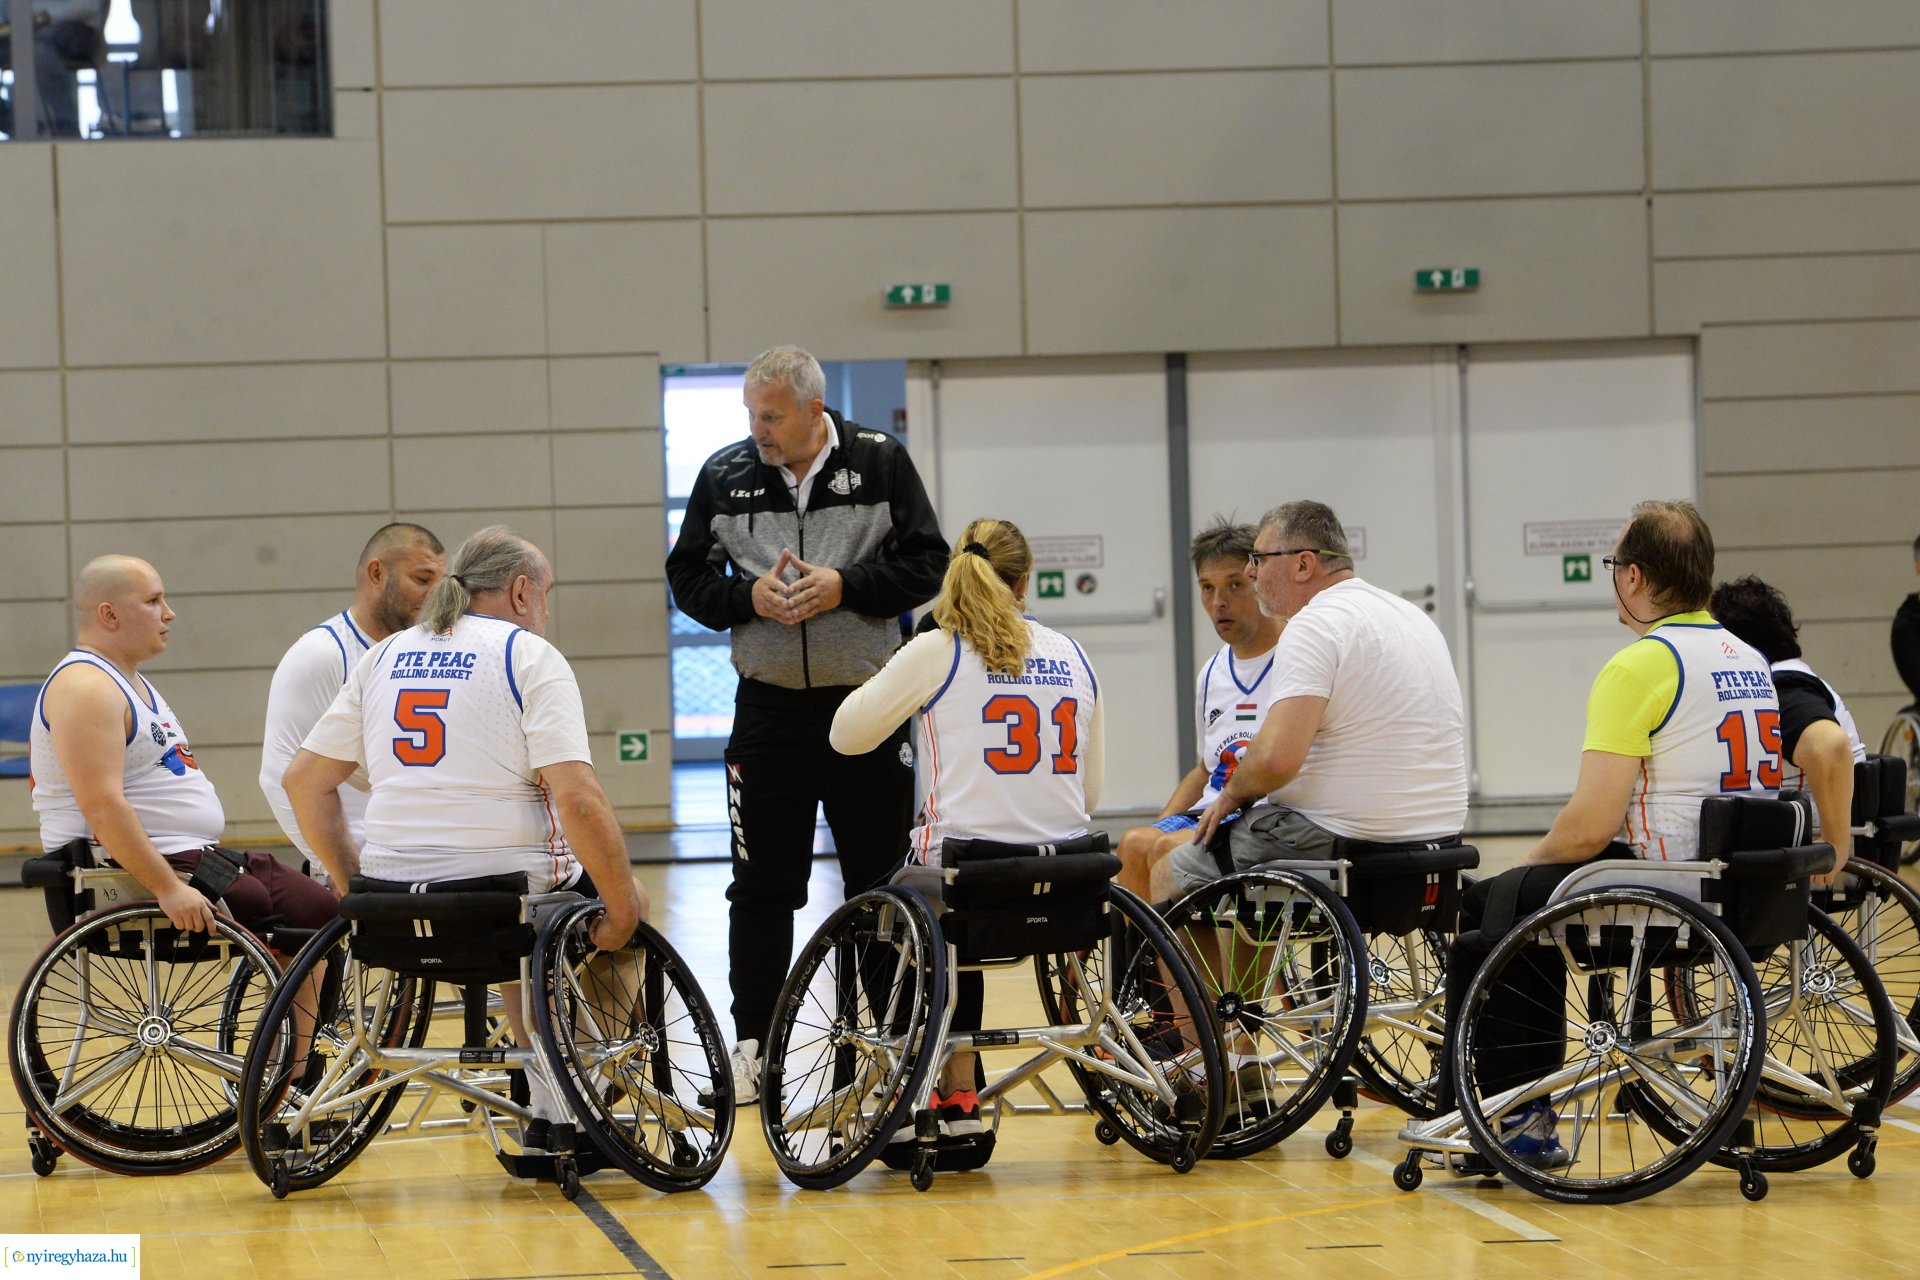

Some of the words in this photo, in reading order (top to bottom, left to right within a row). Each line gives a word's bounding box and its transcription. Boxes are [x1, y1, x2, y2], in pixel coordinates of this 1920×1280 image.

[394, 651, 427, 668] PTE
[427, 651, 477, 669] PEAC
[1026, 658, 1070, 675] PEAC
[390, 668, 430, 680] ROLLING
[430, 668, 473, 680] BASKET
[987, 674, 1032, 685] ROLLING
[1035, 675, 1073, 687] BASKET
[1711, 670, 1741, 689] PTE
[1742, 670, 1770, 687] PEAC
[1717, 689, 1751, 702] ROLLING
[392, 688, 451, 767] 5
[982, 694, 1078, 775] 31
[1716, 709, 1782, 792] 15
[1026, 916, 1048, 924] SPORTA
